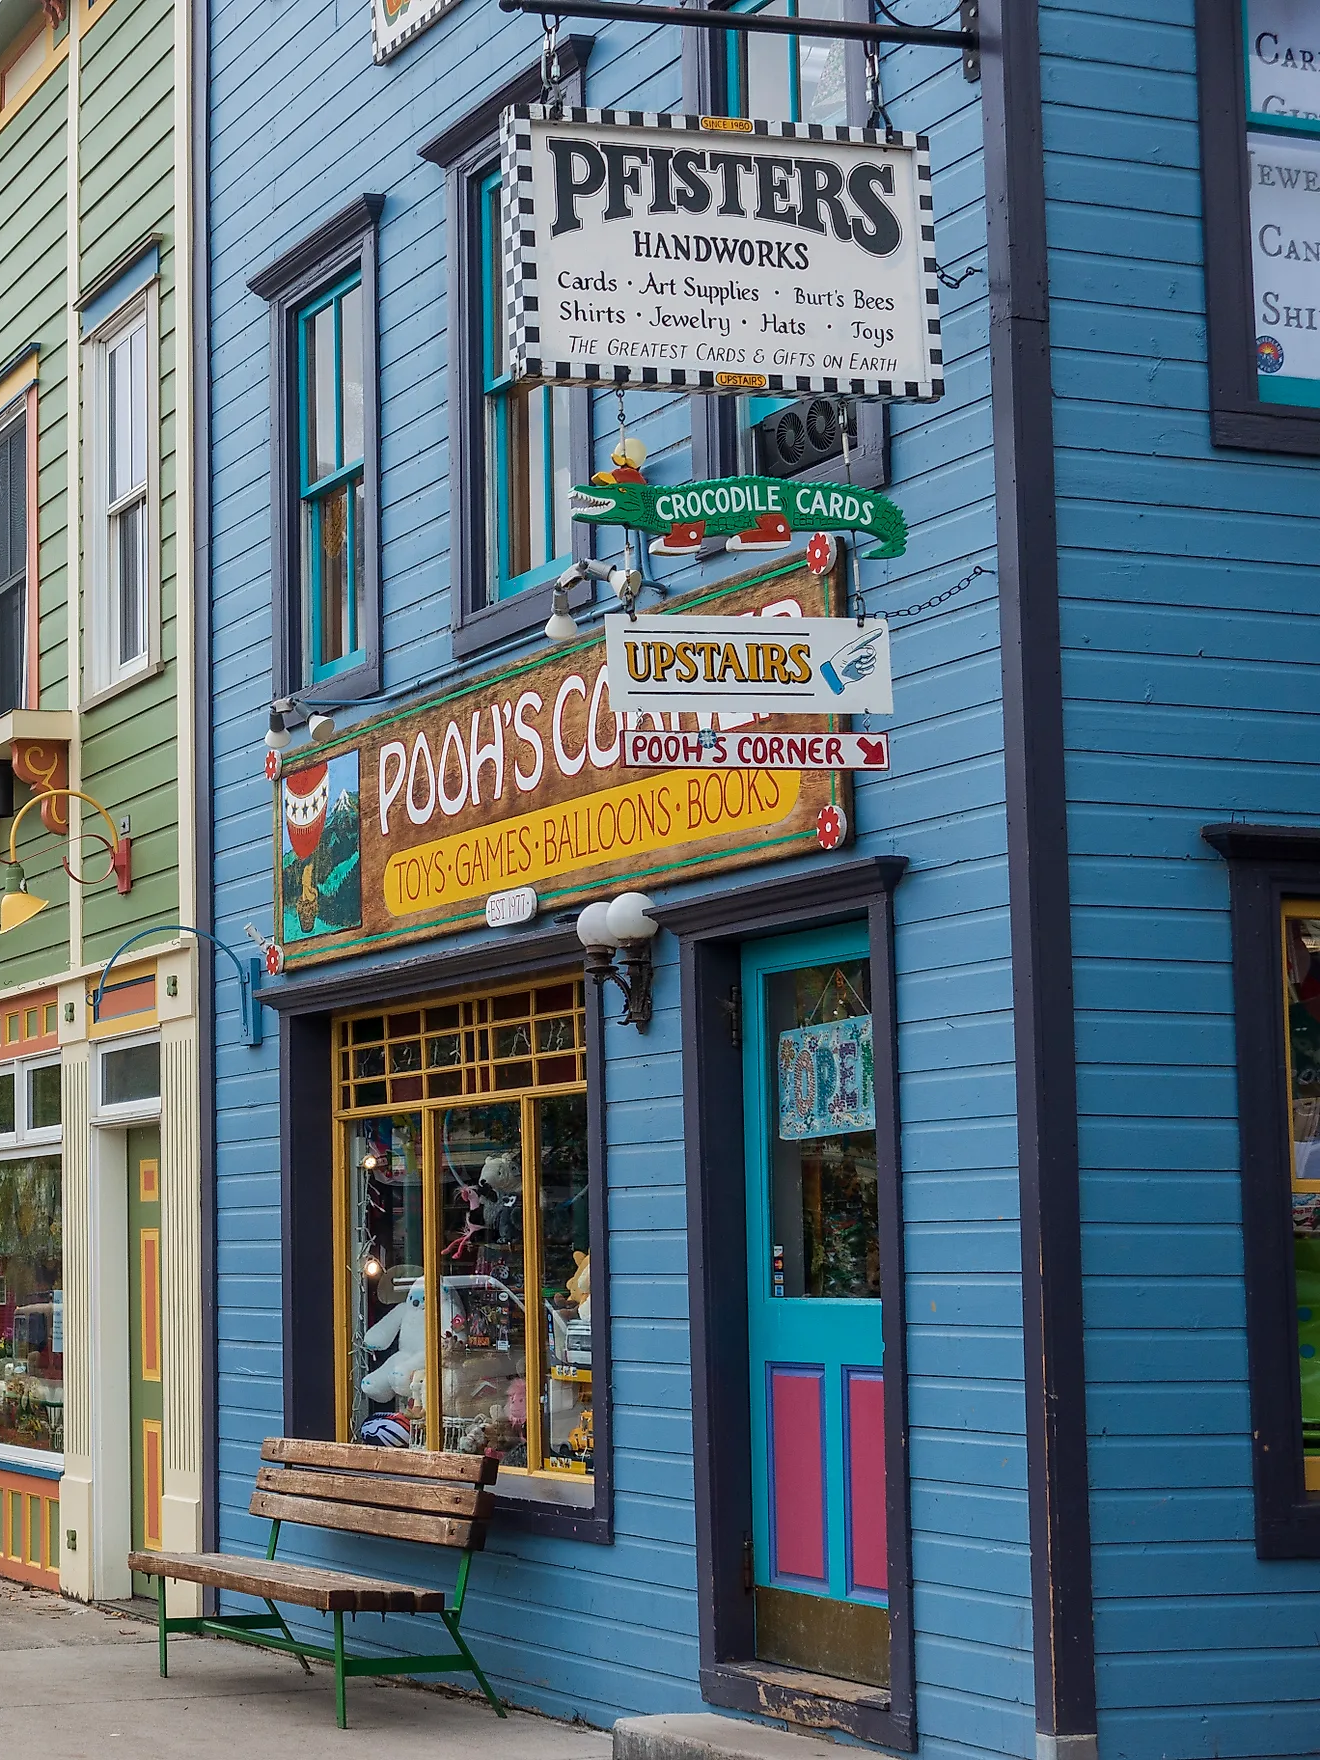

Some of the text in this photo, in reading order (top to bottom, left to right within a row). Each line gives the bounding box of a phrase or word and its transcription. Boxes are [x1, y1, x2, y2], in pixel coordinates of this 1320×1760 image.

[1255, 32, 1320, 72] CAR
[703, 120, 750, 131] SINCE 1980
[547, 136, 902, 258] PFISTERS
[633, 231, 810, 271] HANDWORKS
[557, 271, 895, 311] Cards Art Supplies Burt's Bees
[1262, 291, 1320, 330] SHI
[559, 301, 895, 347] Shirts Jewelry Hats Toys
[568, 335, 898, 373] THE GREATEST CARDS & GIFTS ON EARTH
[720, 375, 763, 386] UPSTAIRS
[655, 486, 874, 525] CROCODILE CARDS
[624, 641, 812, 684] UPSTAIRS
[379, 690, 545, 836] POOH'S
[738, 736, 845, 765] CORNER
[394, 769, 780, 904] TOYS GAMES BALLOONS BOOKS
[490, 898, 506, 922] EST
